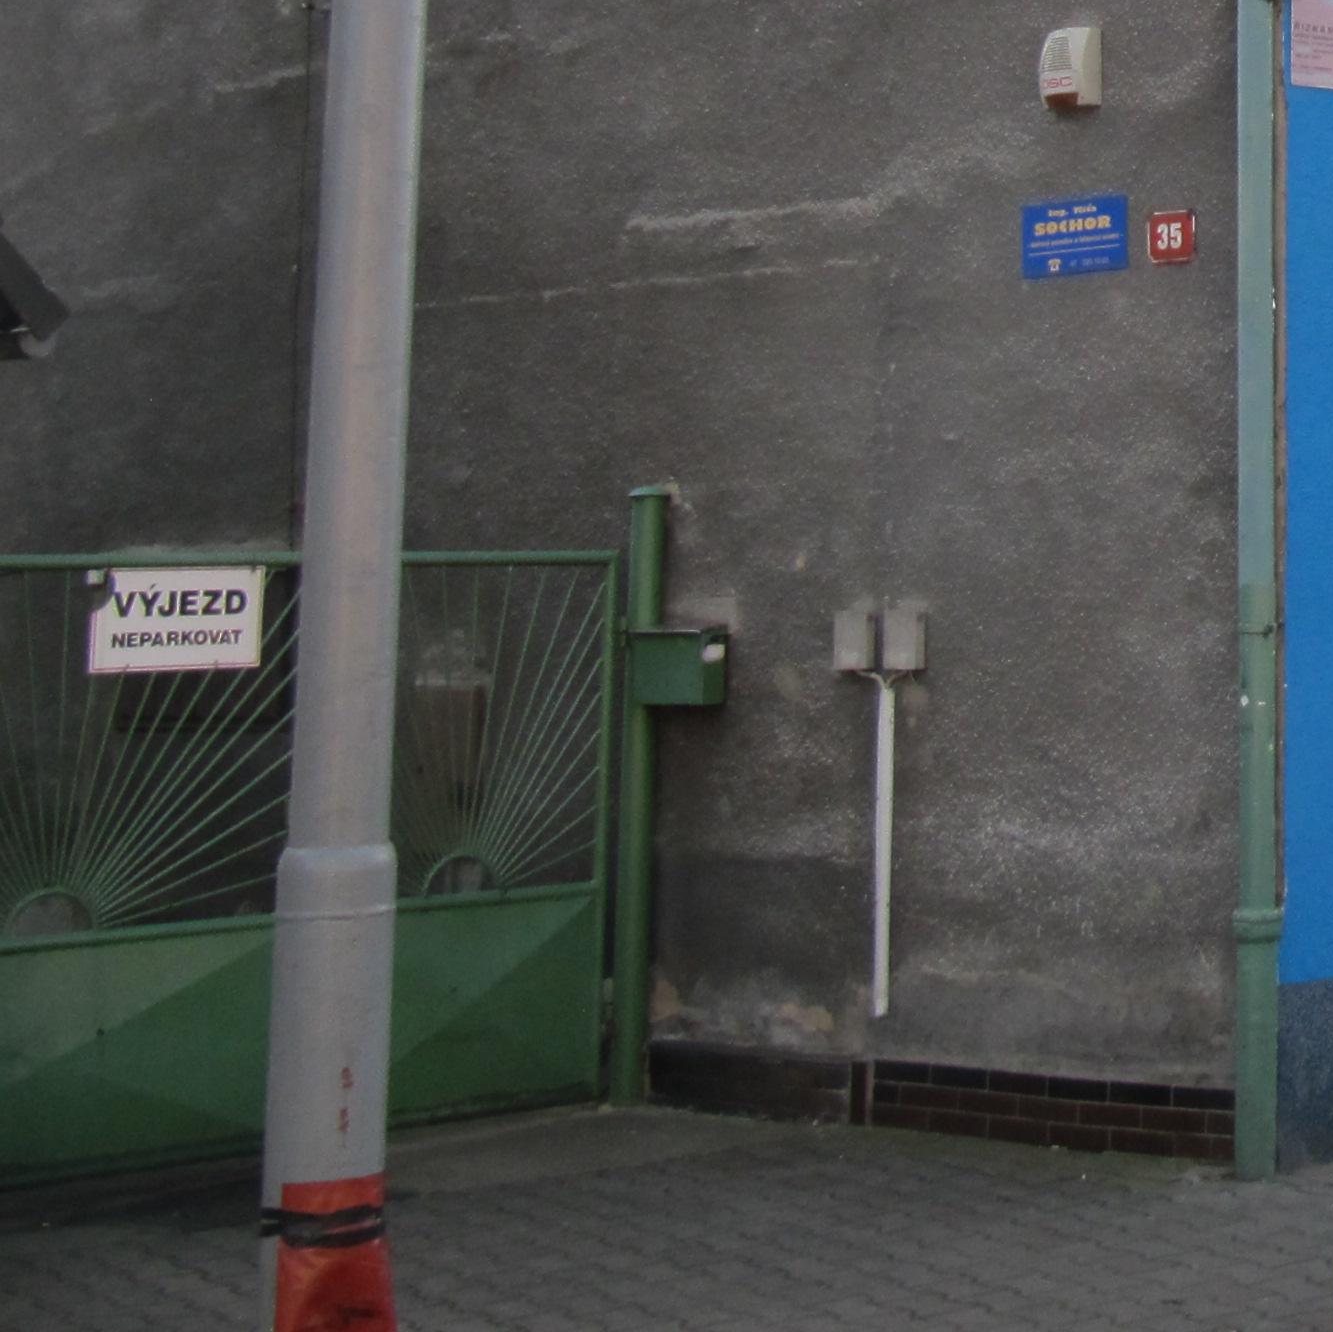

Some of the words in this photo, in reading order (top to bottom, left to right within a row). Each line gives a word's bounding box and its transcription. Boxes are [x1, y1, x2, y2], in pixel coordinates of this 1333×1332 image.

[1034, 215, 1112, 237] SOCHOR
[1157, 222, 1183, 250] 35
[114, 582, 248, 618] VÝJEZD
[111, 629, 243, 648] NEPARKOVAT
